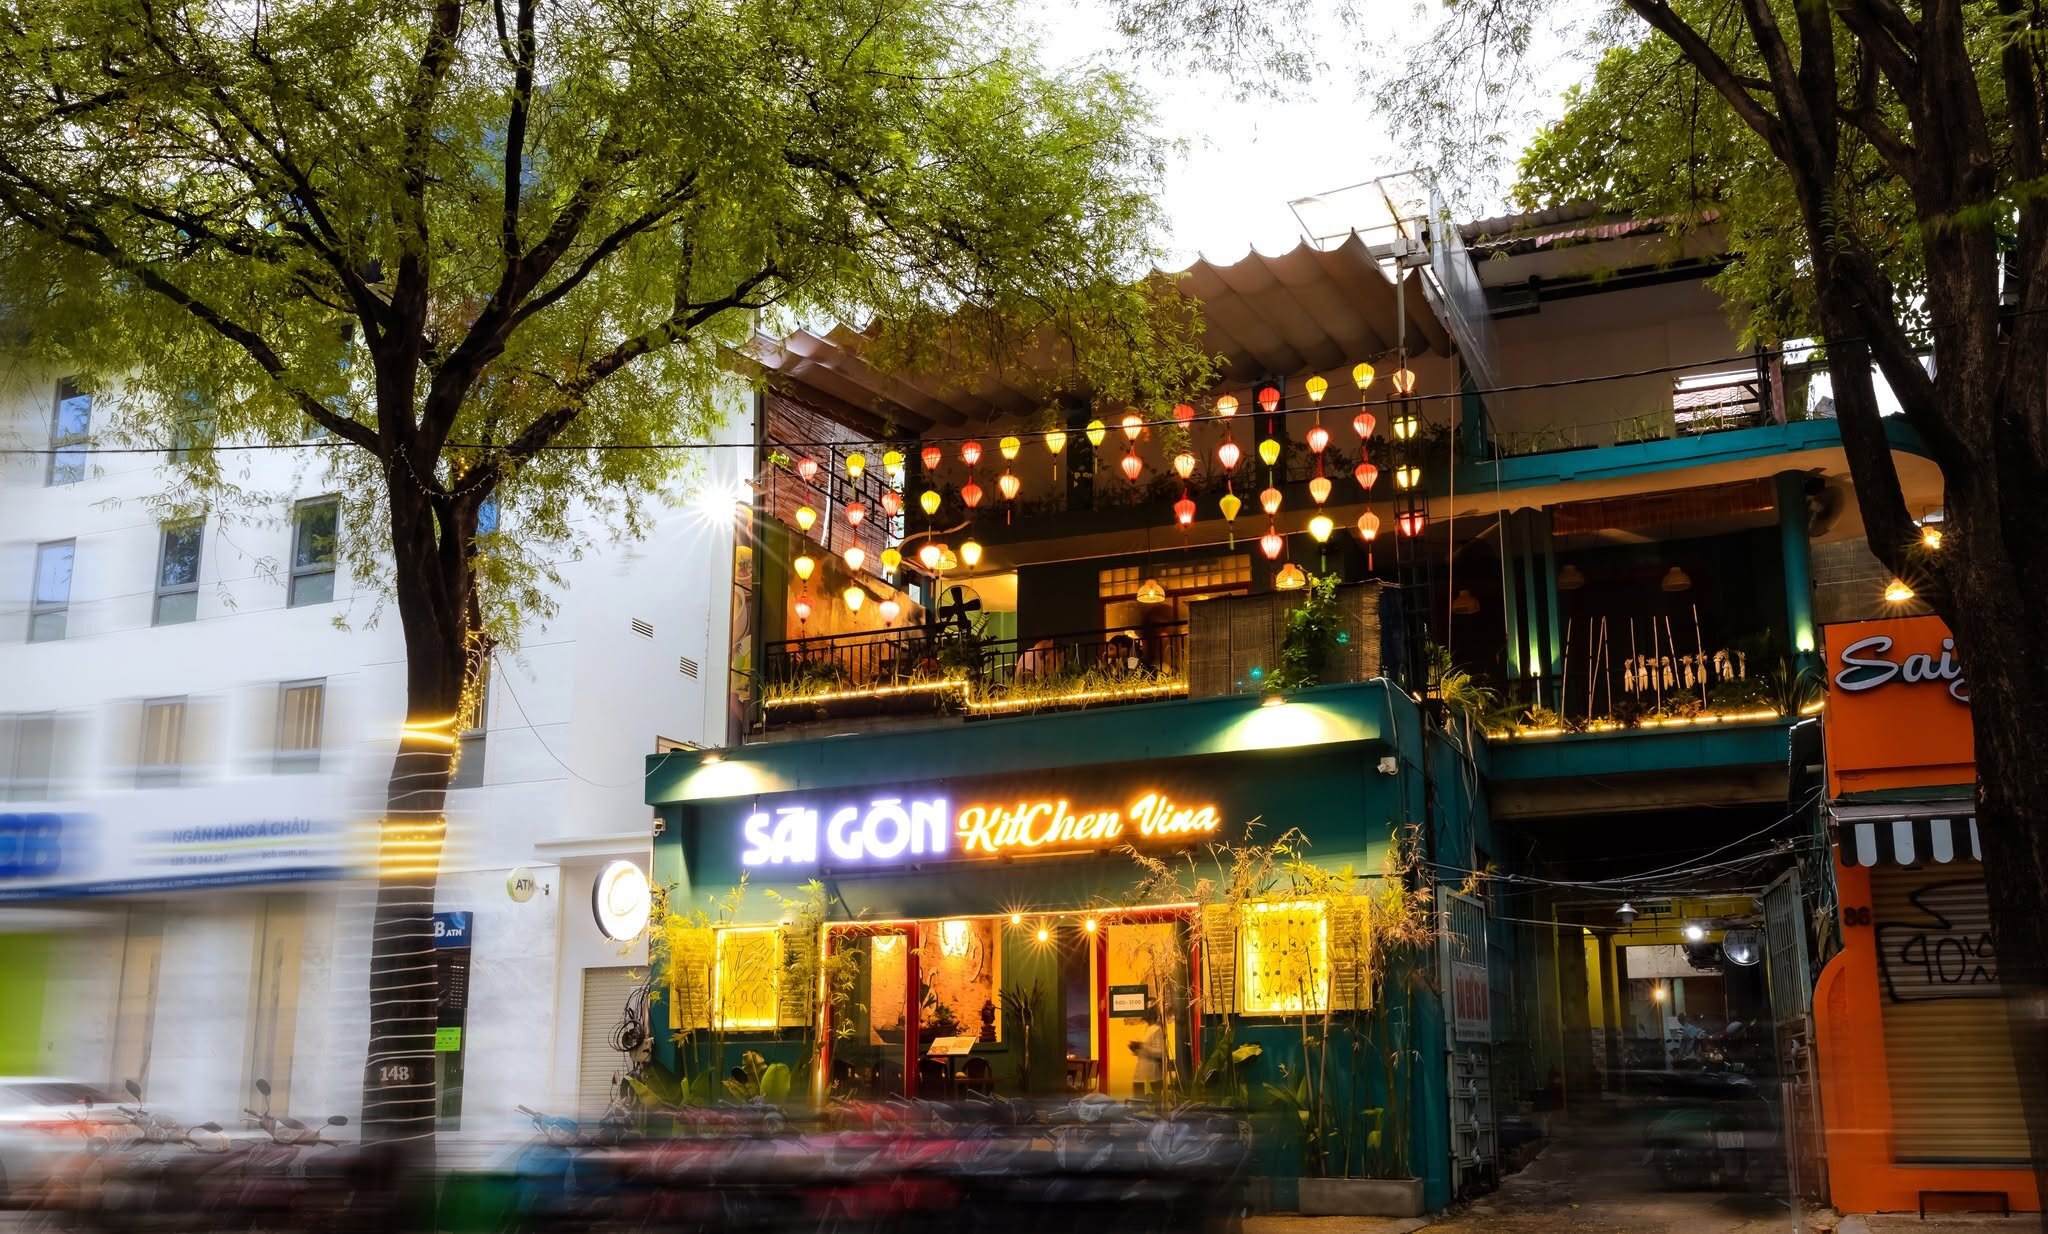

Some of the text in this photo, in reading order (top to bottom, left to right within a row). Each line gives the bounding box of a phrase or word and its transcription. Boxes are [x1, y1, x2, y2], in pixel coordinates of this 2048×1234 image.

[1130, 793, 1221, 835] Vina
[446, 929, 462, 937] ATM
[380, 1066, 410, 1081] 148
